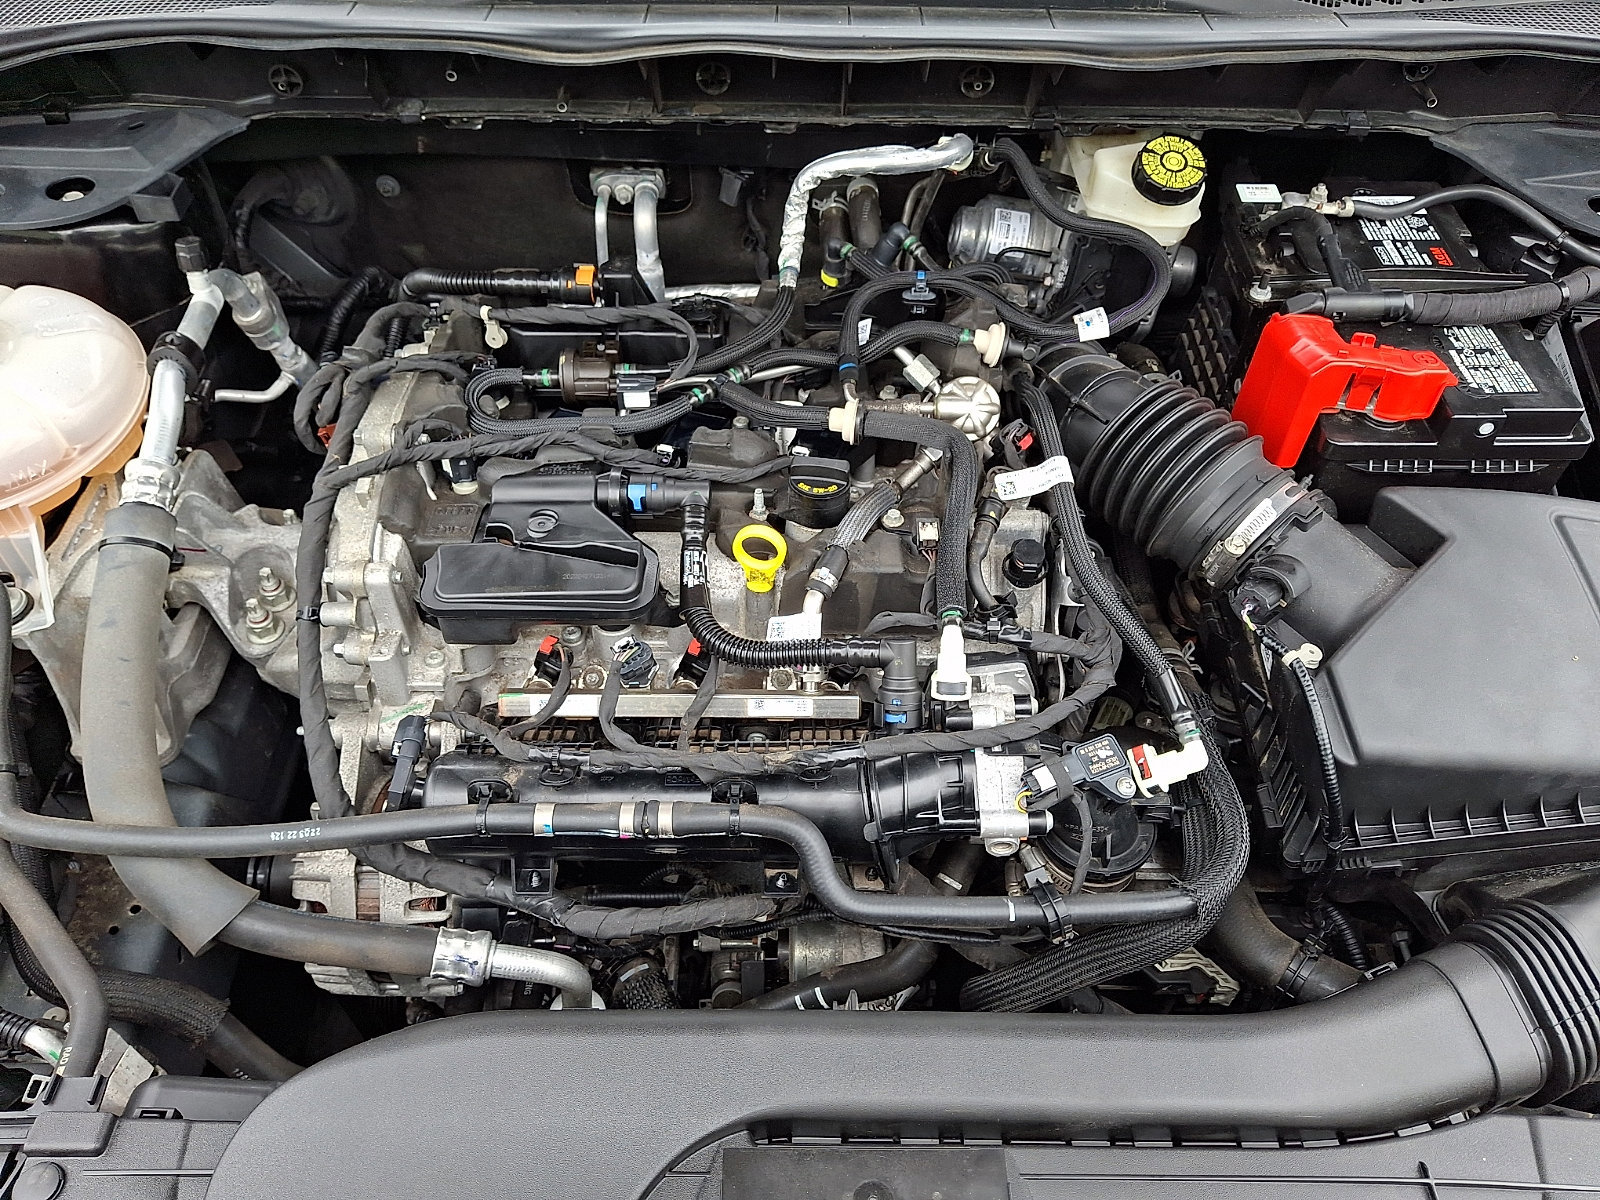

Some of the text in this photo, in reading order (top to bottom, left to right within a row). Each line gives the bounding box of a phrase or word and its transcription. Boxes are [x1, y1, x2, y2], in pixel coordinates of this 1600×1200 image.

[1429, 247, 1448, 266] AGM
[9, 459, 47, 488] MAX
[812, 484, 838, 494] 5W-20
